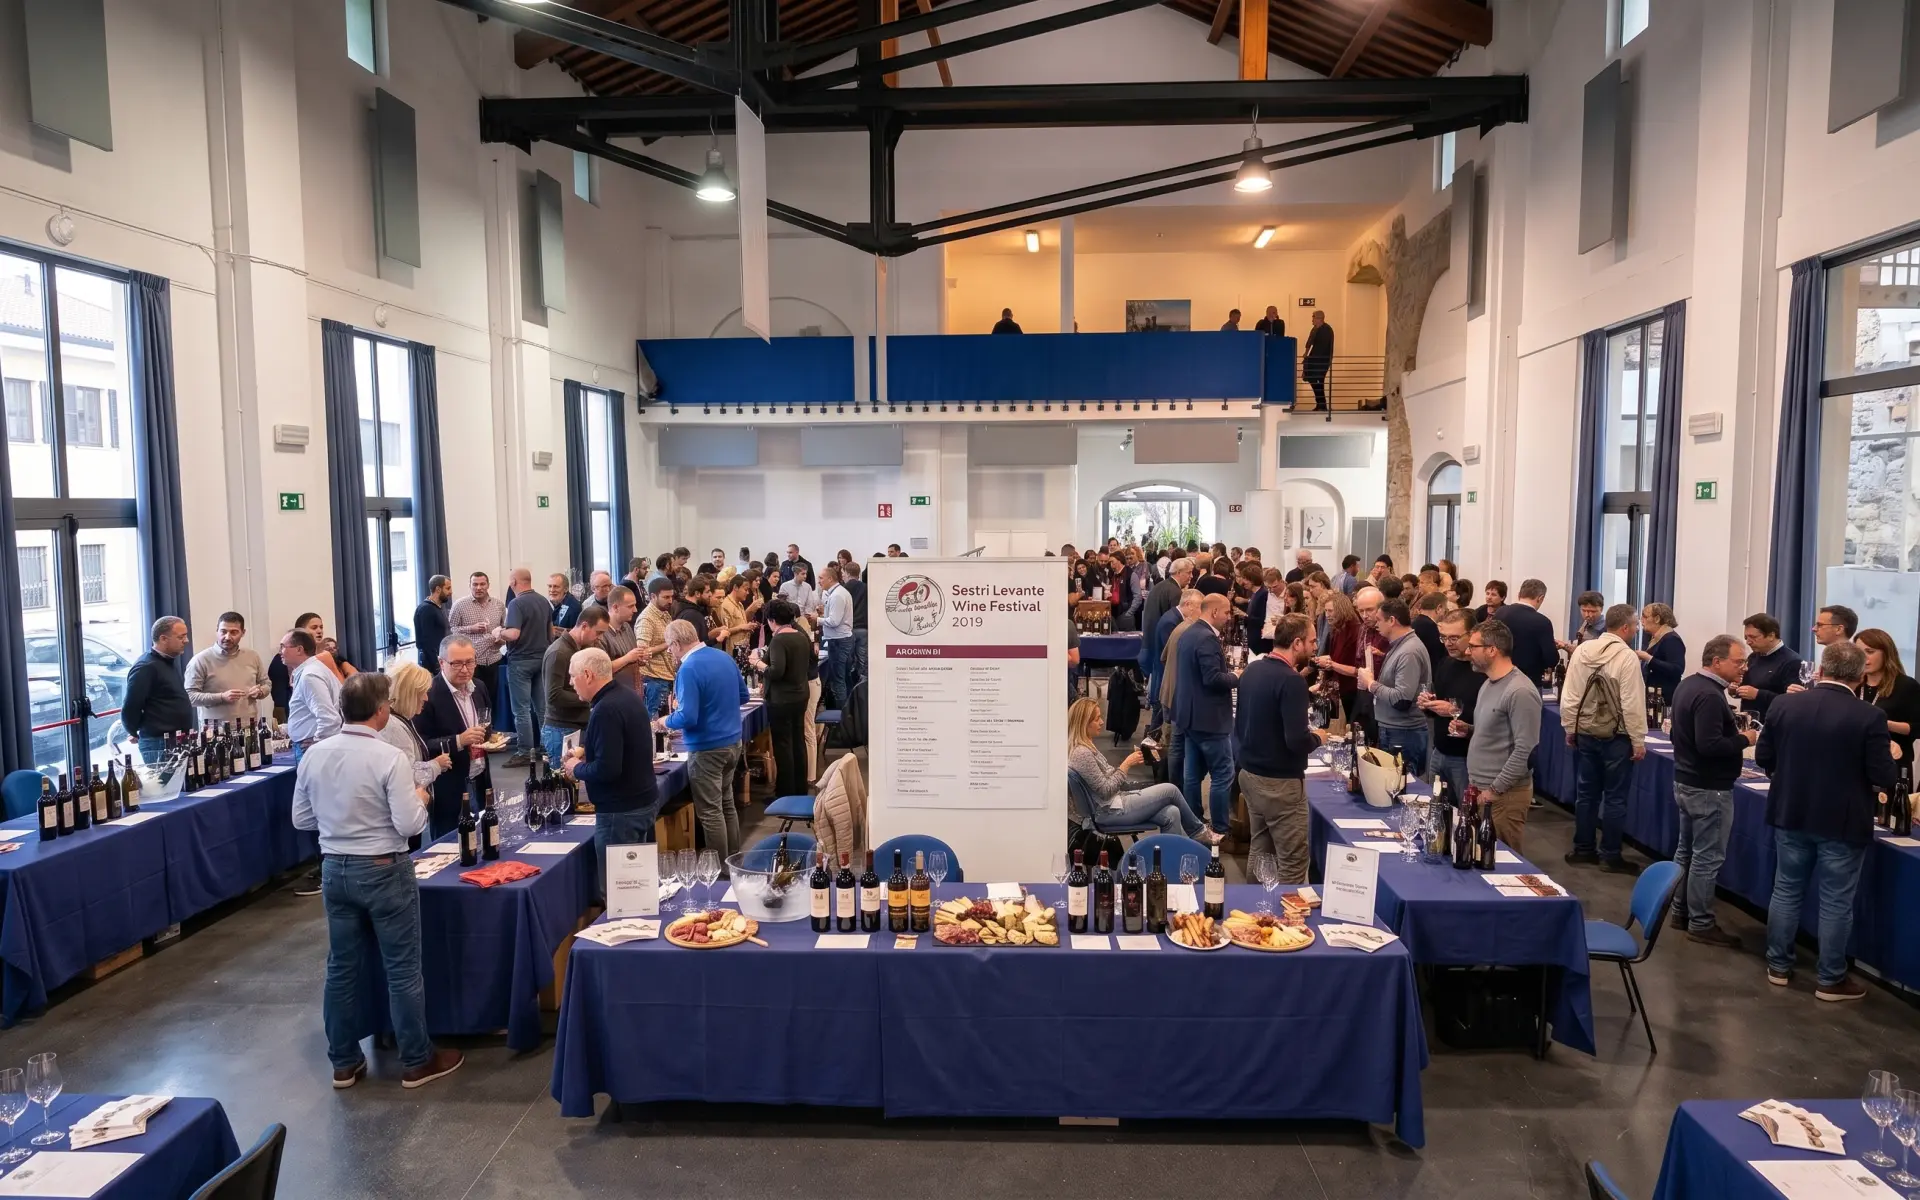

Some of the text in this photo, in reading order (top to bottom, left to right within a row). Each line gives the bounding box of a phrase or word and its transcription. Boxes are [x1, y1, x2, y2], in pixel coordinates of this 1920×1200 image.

[952, 584, 1045, 596] Sestri Levante
[952, 600, 987, 612] Wine
[990, 600, 1041, 612] Festival
[952, 617, 983, 627] 2019
